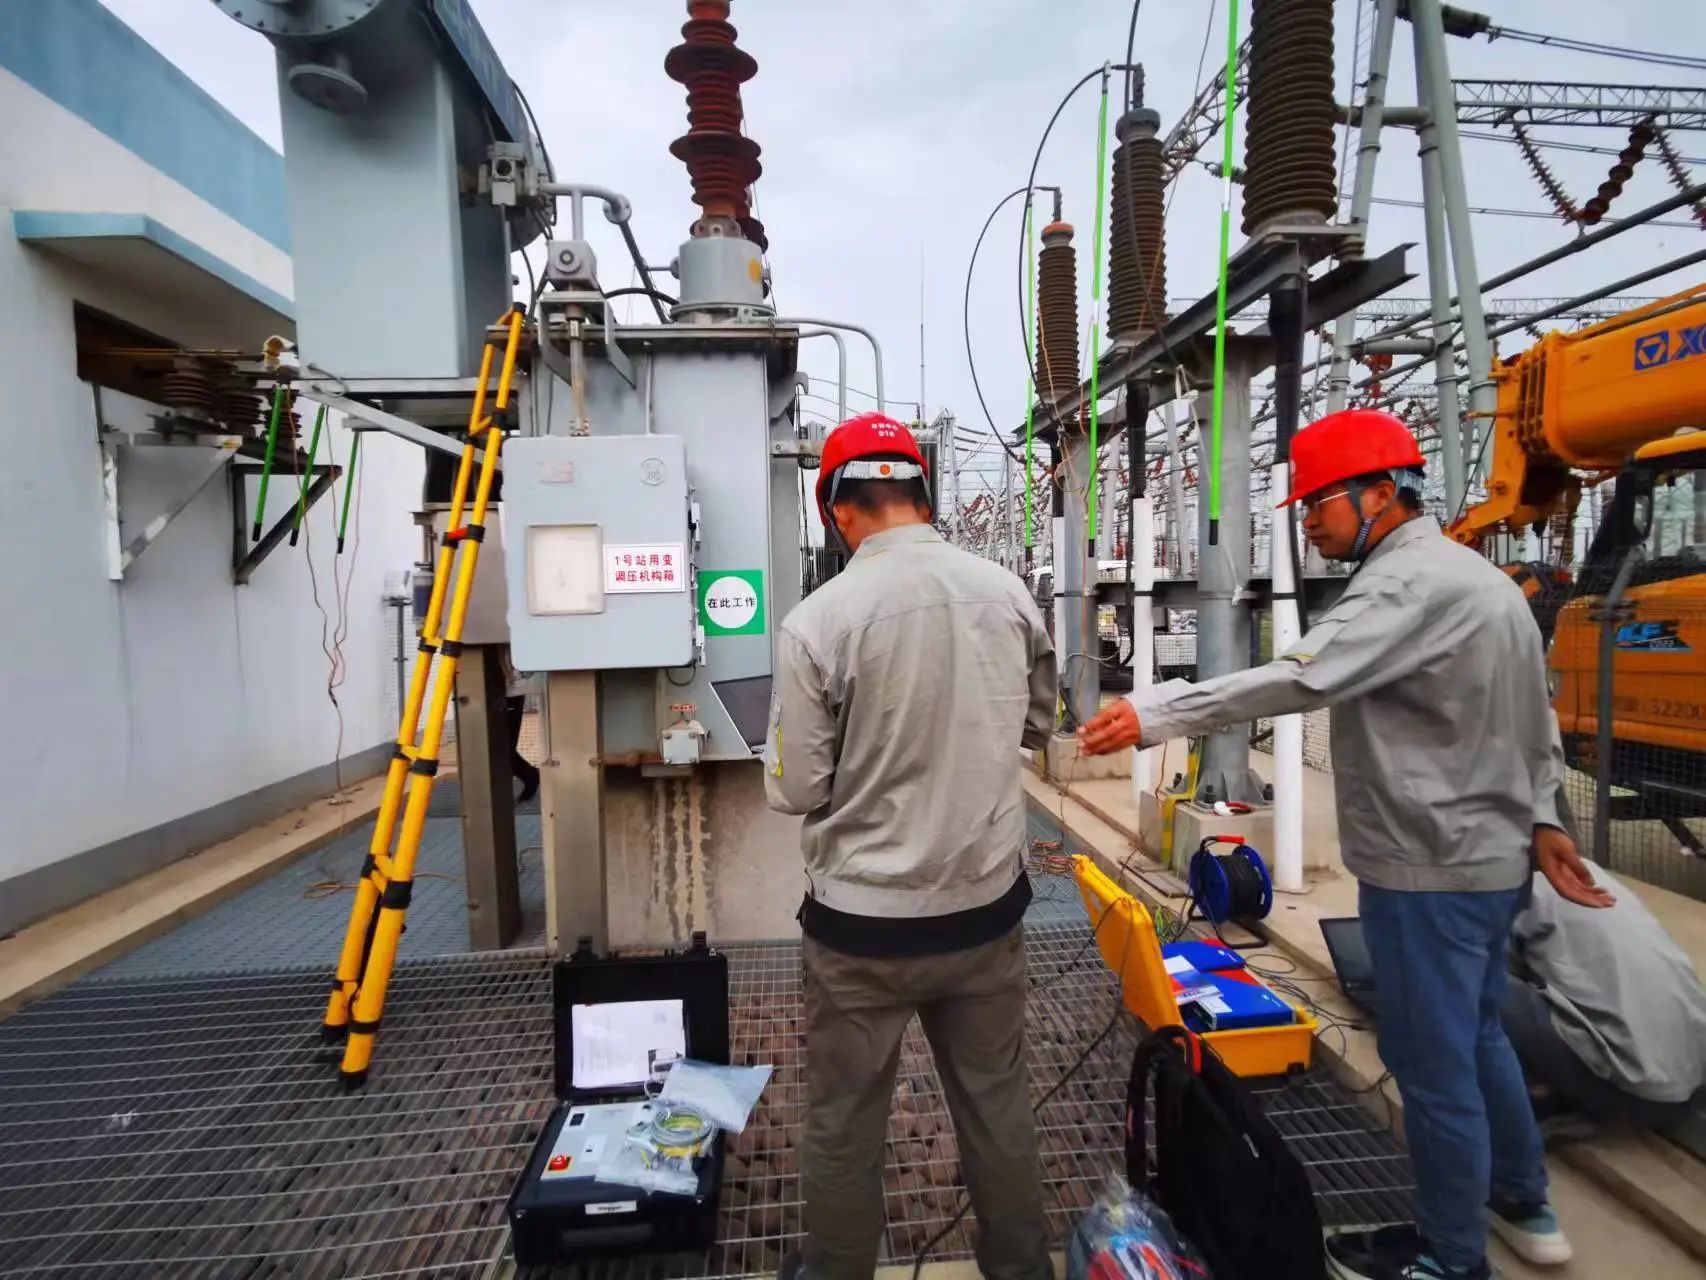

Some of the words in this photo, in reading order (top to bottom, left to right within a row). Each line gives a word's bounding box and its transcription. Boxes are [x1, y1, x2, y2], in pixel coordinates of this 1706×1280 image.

[614, 554, 673, 566] 1号站用变
[615, 570, 674, 582] 调压机构箱
[707, 597, 756, 609] 在此工作
